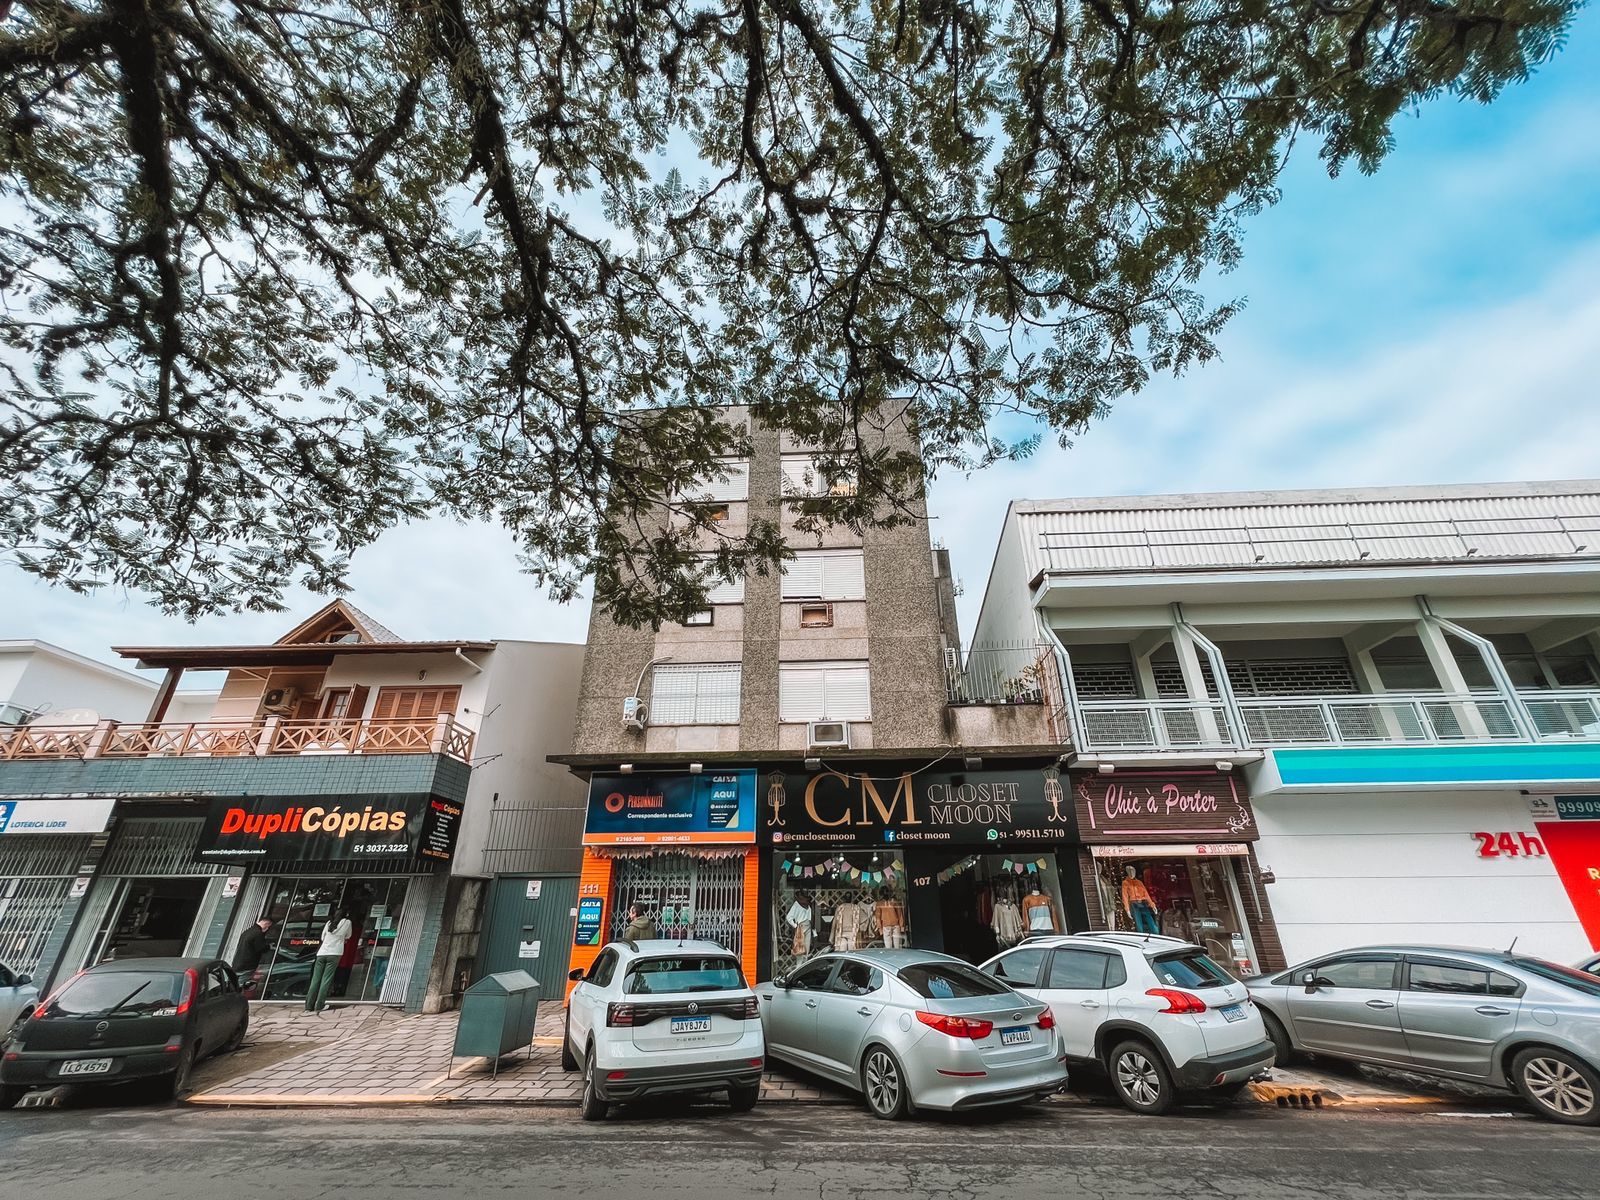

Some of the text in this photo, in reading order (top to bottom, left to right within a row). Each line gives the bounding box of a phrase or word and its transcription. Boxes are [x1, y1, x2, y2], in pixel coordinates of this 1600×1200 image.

[712, 775, 737, 783] CAIXA
[713, 790, 736, 799] AQUI
[927, 782, 1019, 803] CLOSET
[804, 771, 922, 827] CM
[1105, 783, 1218, 819] Chic à Porter
[627, 812, 667, 820] Correspondente
[930, 804, 1012, 825] MOON
[220, 805, 407, 840] DupliCópias
[783, 831, 856, 842] @cmclosetmoon
[896, 831, 951, 840] closet moon
[999, 831, 1009, 839] 51
[1015, 828, 1065, 839] 99511.5710
[365, 844, 409, 852] 3037.3222
[1471, 832, 1546, 857] 24h
[913, 876, 931, 887] 107
[582, 884, 599, 894] 111
[675, 1021, 708, 1031] JAY8J76
